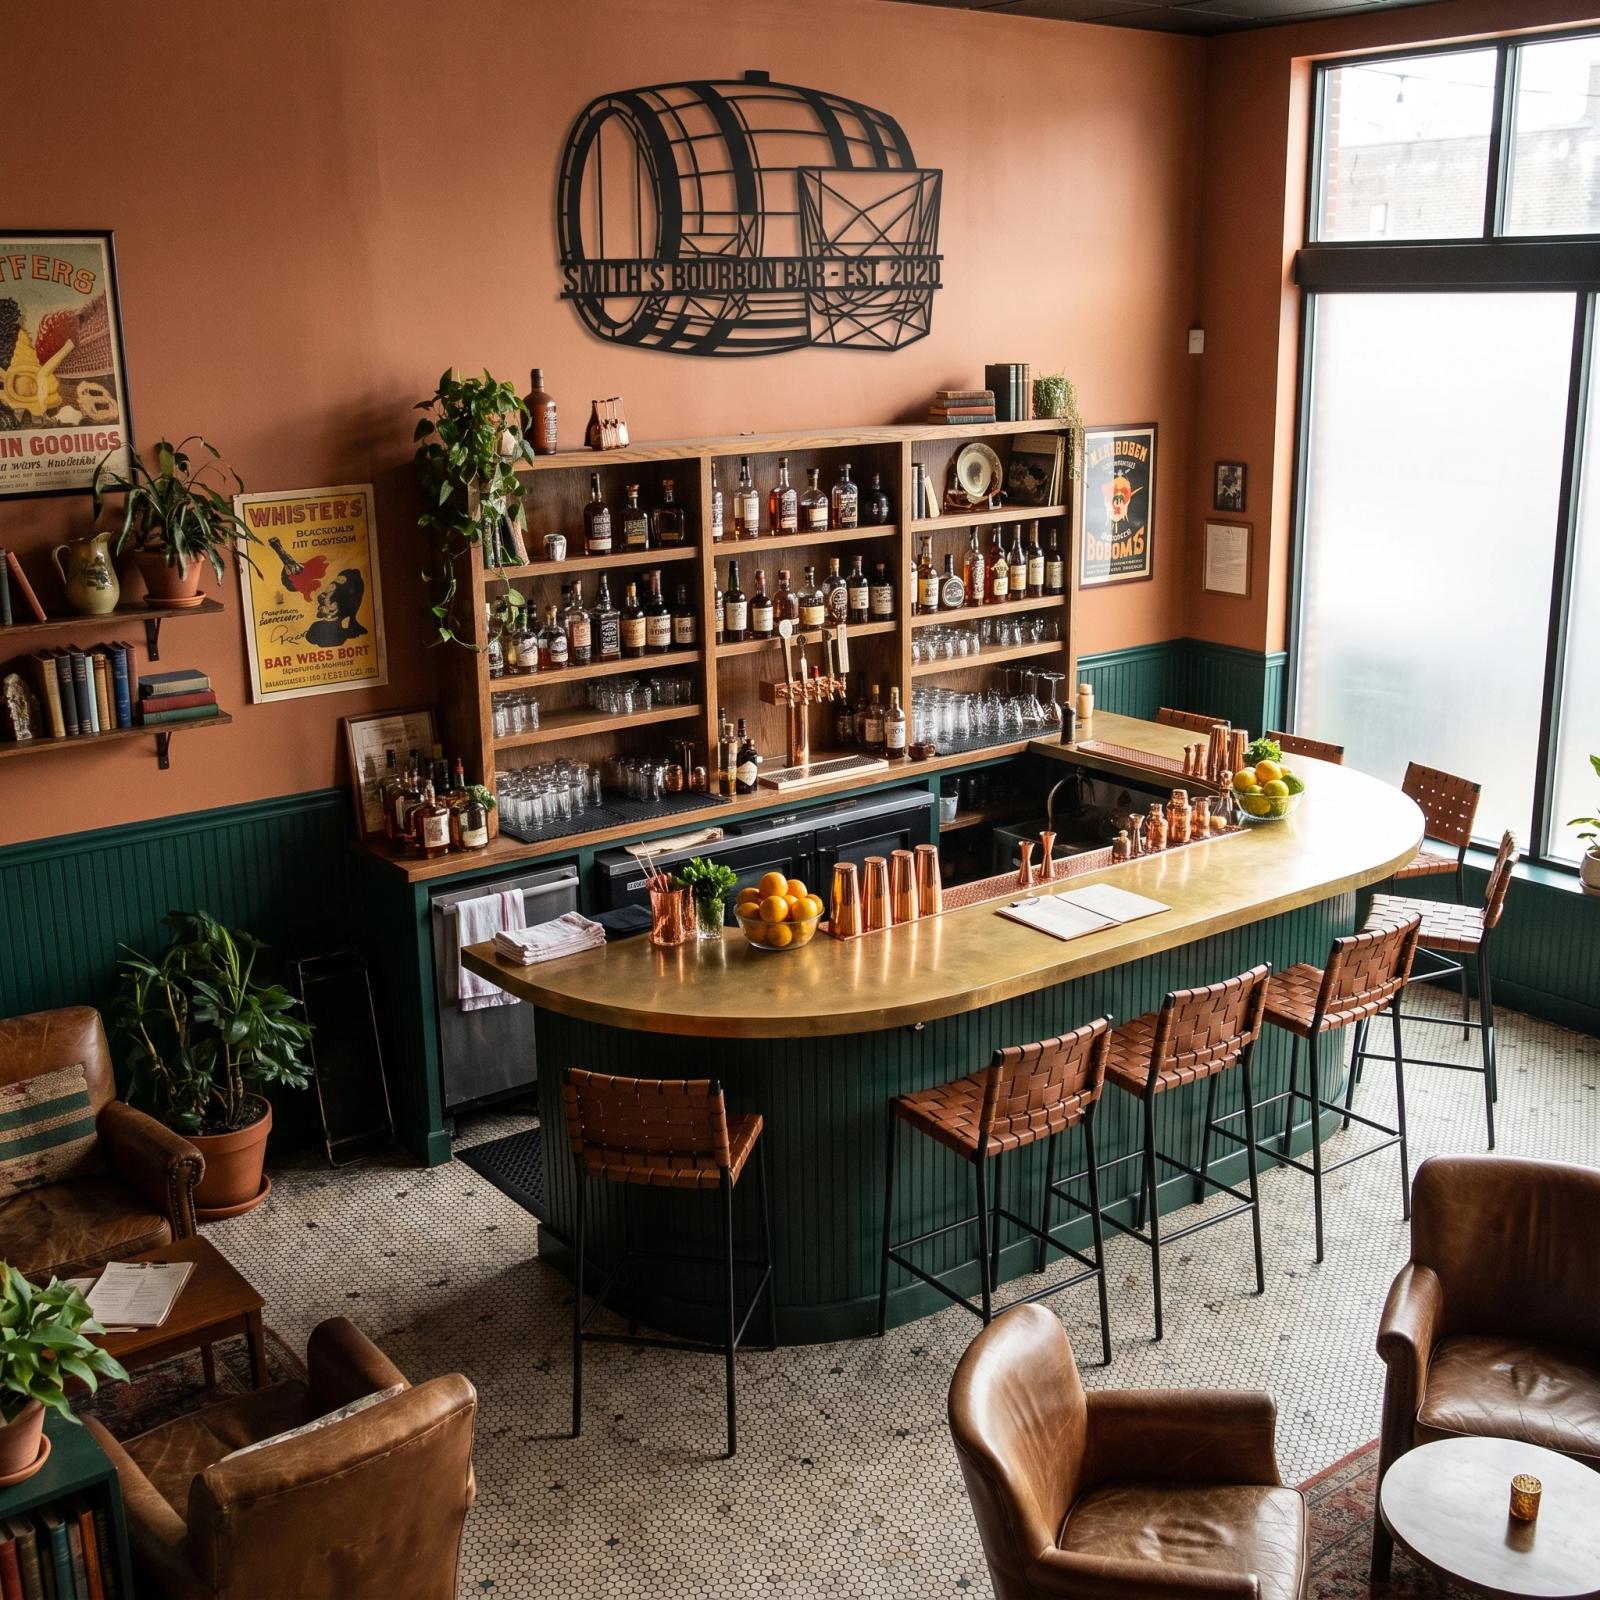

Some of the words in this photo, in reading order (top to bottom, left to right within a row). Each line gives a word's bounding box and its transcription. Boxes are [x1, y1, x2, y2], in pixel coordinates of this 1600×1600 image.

[563, 263, 665, 294] SMITH'S
[671, 261, 777, 292] BOURBON
[783, 260, 826, 288] BAR
[845, 258, 884, 287] EST.
[890, 259, 941, 285] 2020
[264, 655, 292, 670] BAR
[337, 645, 370, 660] BORT
